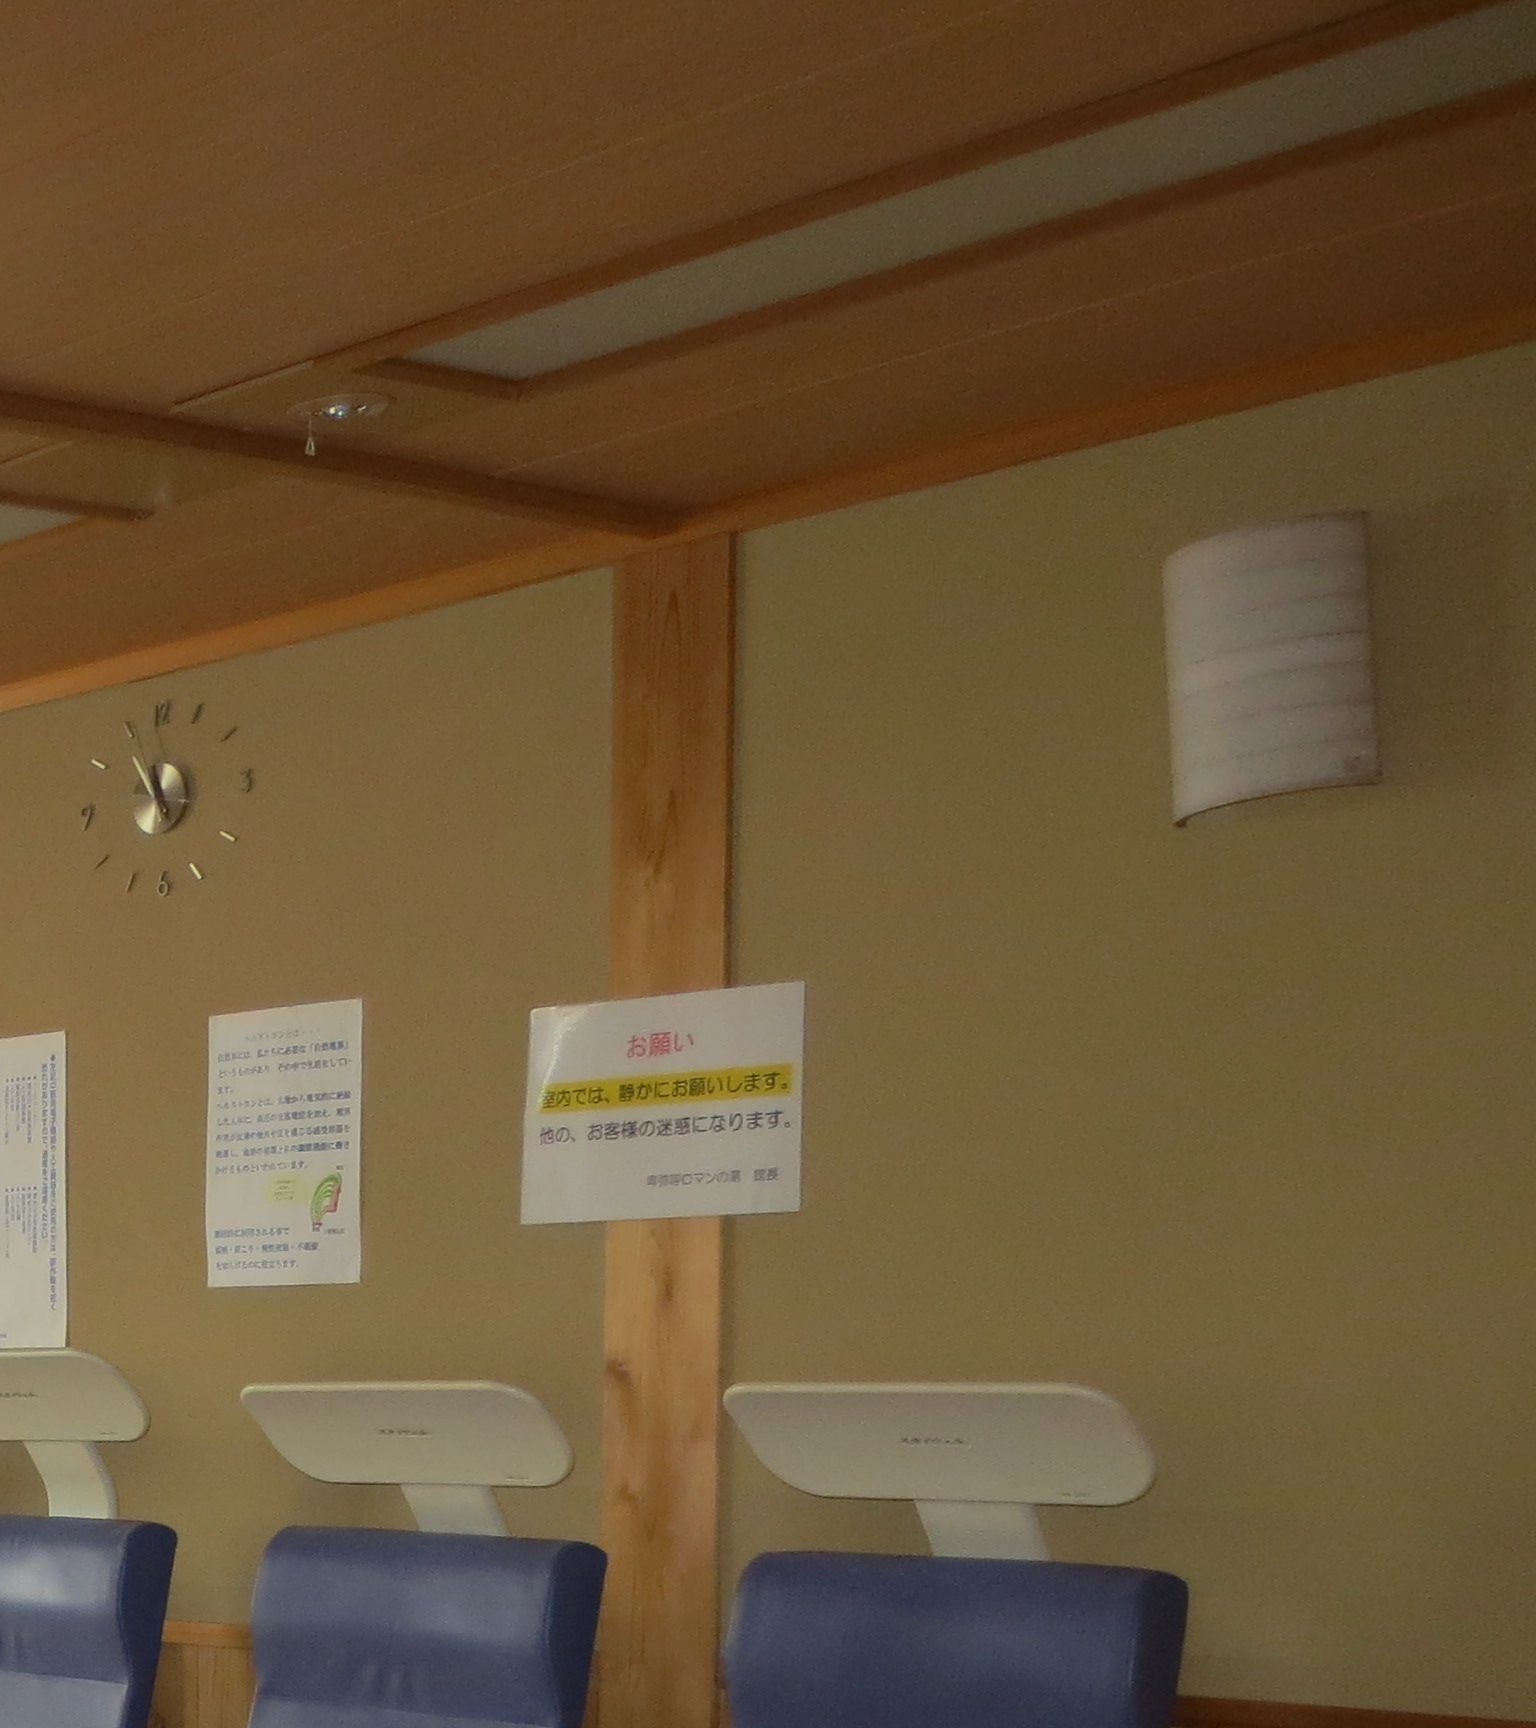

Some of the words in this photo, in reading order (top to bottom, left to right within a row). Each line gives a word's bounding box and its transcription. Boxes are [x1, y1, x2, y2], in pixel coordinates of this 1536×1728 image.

[156, 870, 171, 897] 6
[627, 1031, 695, 1058] お願い
[542, 1071, 791, 1109] 室内では、静かにお願いします。
[539, 1109, 793, 1145] 他の、お客様の迷惑になります。
